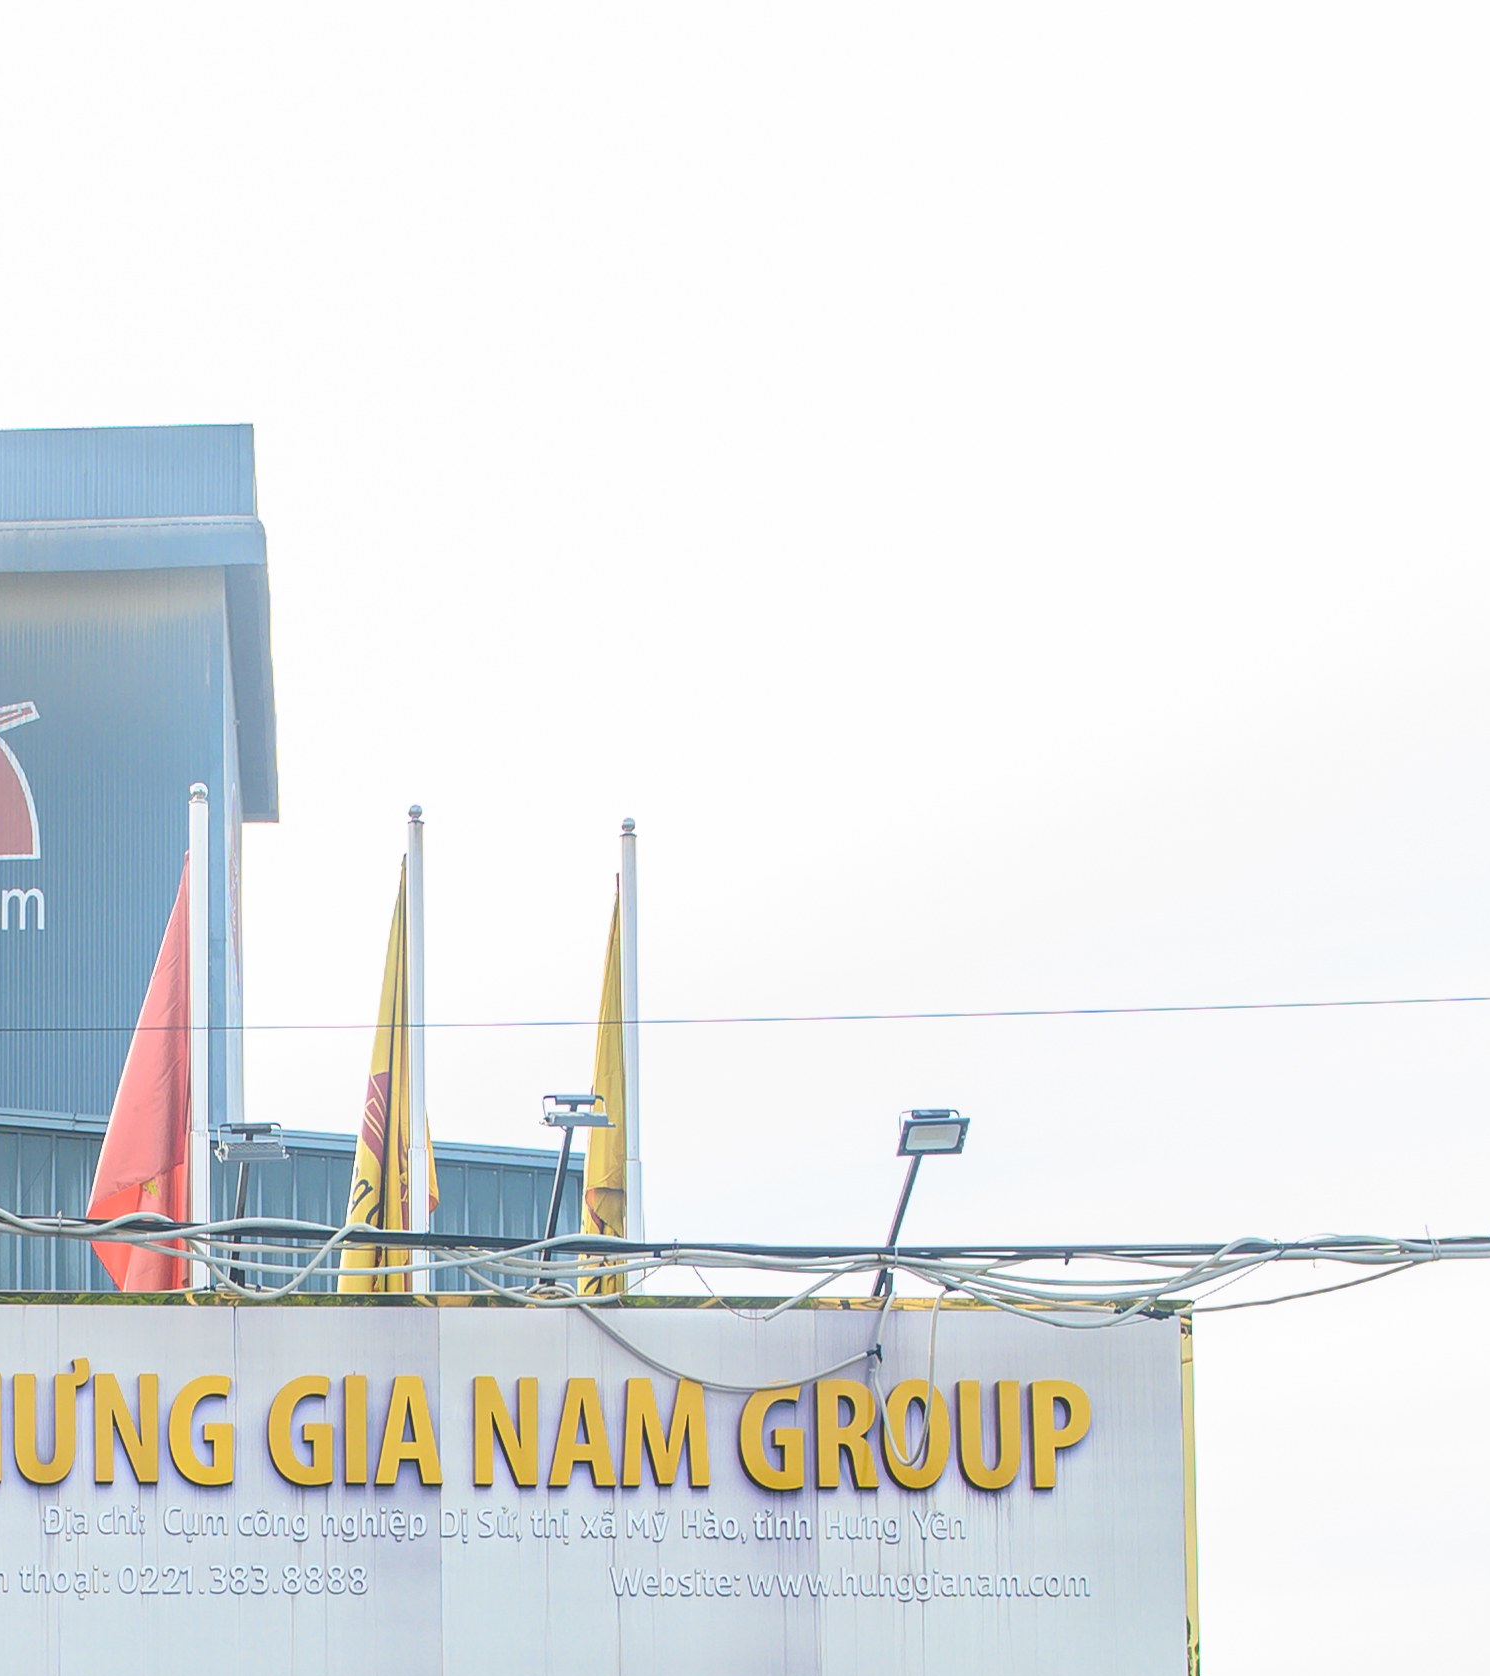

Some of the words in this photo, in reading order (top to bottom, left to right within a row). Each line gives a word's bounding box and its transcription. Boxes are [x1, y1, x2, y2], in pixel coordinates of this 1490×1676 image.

[269, 1375, 443, 1486] GIA
[474, 1376, 711, 1488] NAM
[740, 1379, 1091, 1490] GROUP
[44, 1506, 89, 1541] Địa
[97, 1503, 146, 1538] chỉ:
[164, 1507, 228, 1543] Cụm
[237, 1506, 309, 1543] công
[321, 1506, 427, 1543] nghiệp
[440, 1509, 469, 1542] Dị
[531, 1507, 568, 1543] thị
[581, 1511, 617, 1540] xã
[626, 1510, 667, 1545] Mỹ
[681, 1509, 748, 1544] Hào,
[753, 1505, 813, 1540] tỉnh
[825, 1511, 901, 1544] Hưng
[913, 1508, 966, 1540] Yên
[19, 1563, 111, 1600] thoại:
[118, 1564, 369, 1597] 0221.383.8888
[610, 1567, 741, 1599] Website:
[748, 1567, 1092, 1603] www.hunggianam.com
